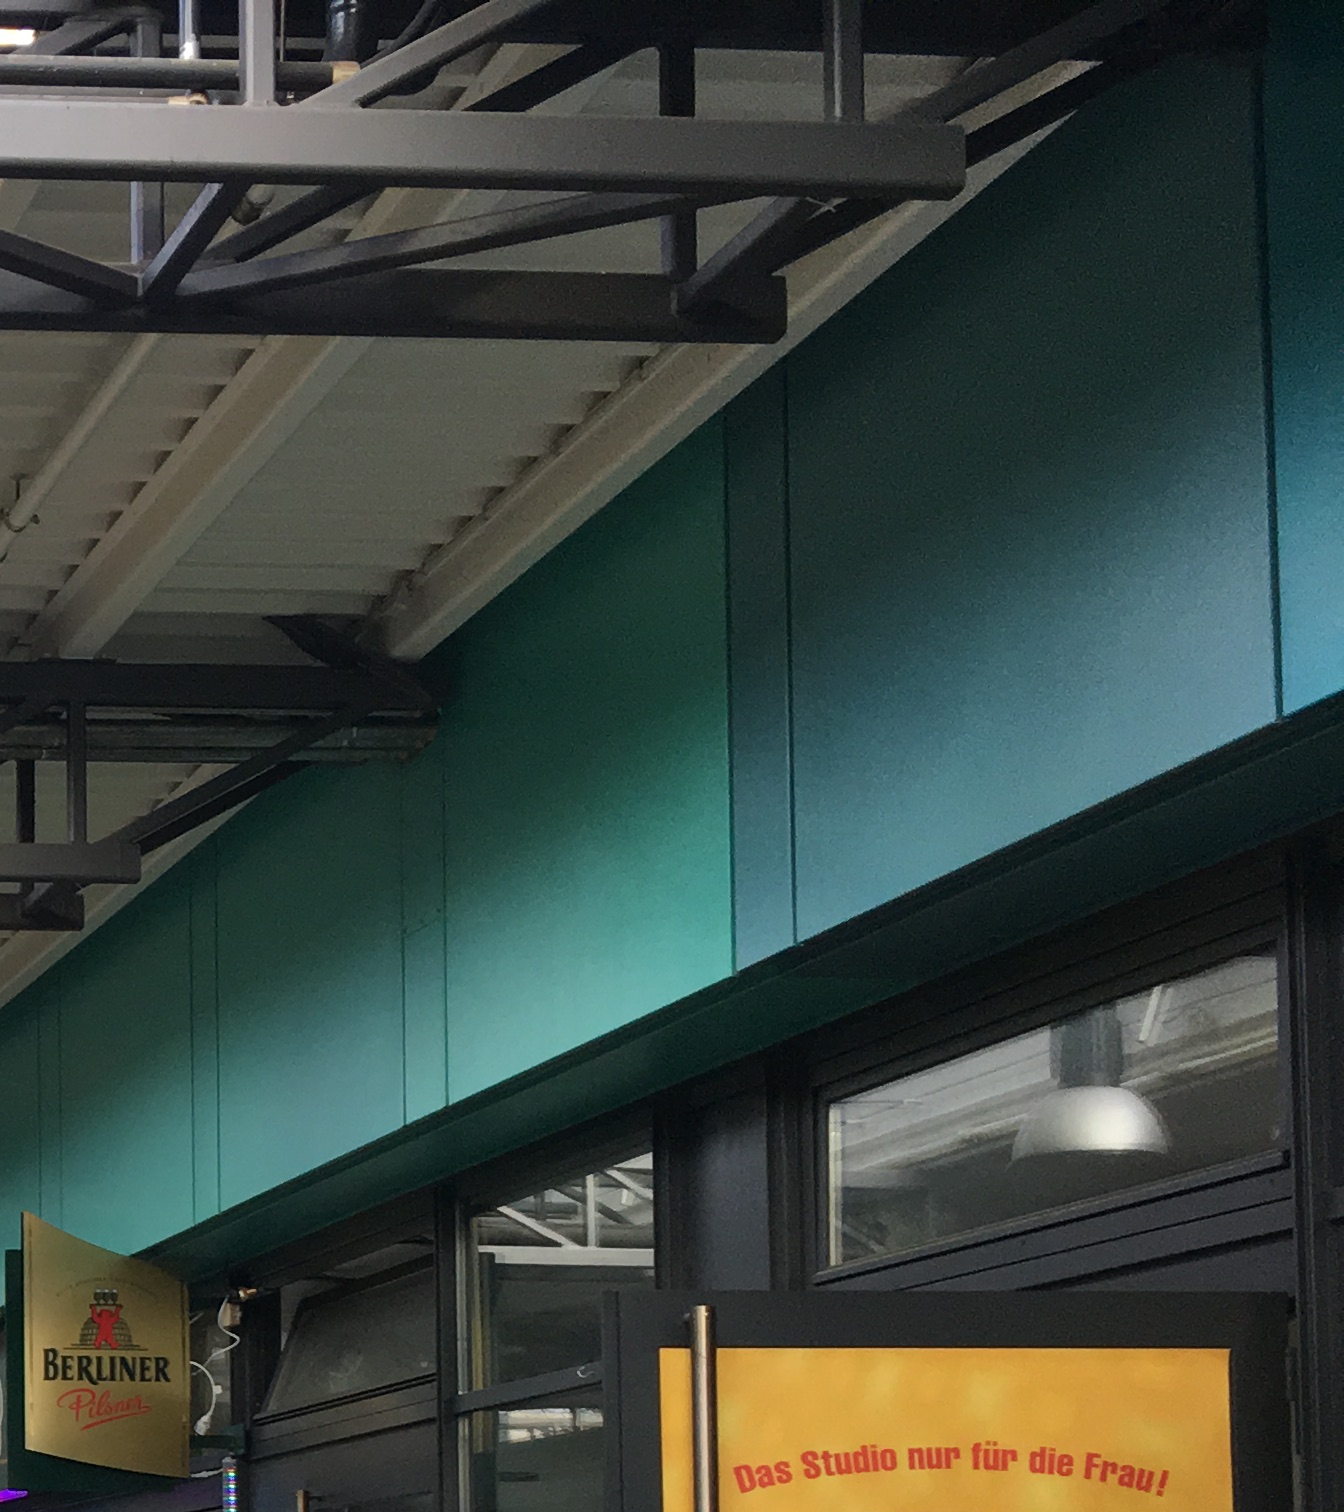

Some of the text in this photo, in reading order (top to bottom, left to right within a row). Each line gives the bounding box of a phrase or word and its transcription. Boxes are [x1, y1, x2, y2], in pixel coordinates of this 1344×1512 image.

[43, 1347, 171, 1385] BERLINER
[57, 1388, 153, 1423] Pilsner
[733, 1441, 1170, 1497] Das Studio nur für die Frau!
